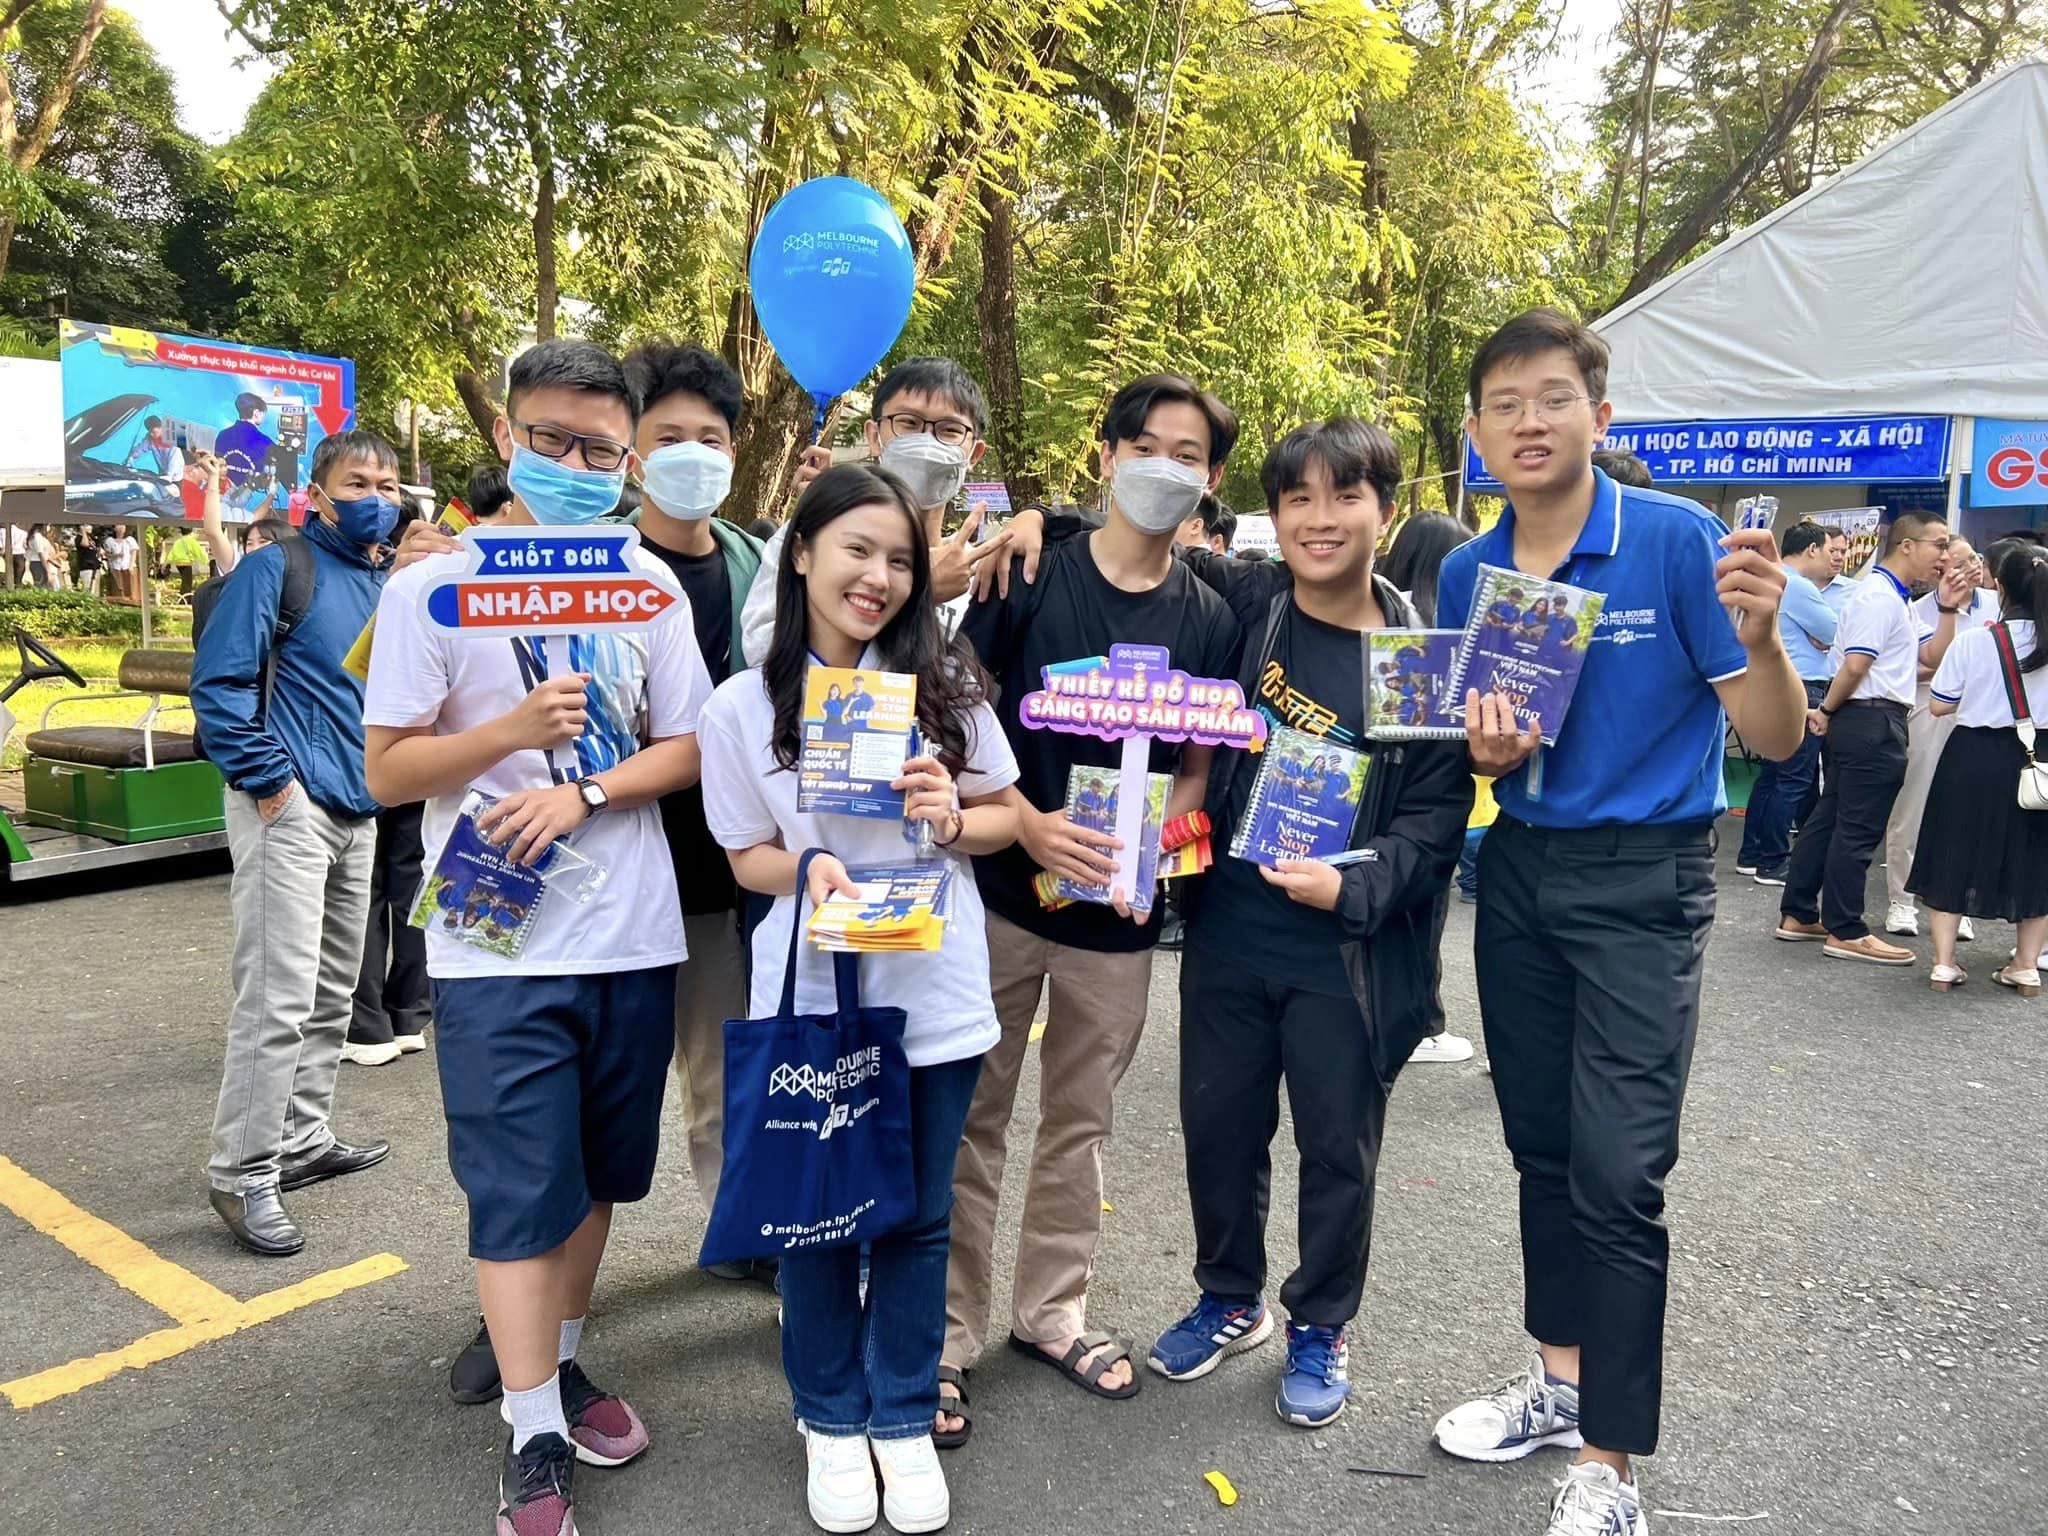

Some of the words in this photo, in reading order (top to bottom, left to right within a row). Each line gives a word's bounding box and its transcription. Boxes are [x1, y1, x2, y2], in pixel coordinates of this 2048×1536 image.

[817, 231, 880, 248] MELBOURNE
[817, 240, 879, 257] POLYTECHNIC
[821, 257, 851, 277] FPT
[167, 349, 198, 364] Xưởng
[199, 354, 220, 366] thực
[222, 357, 238, 369] tập
[259, 362, 287, 375] ngành
[1645, 432, 1690, 454] HỌC
[1696, 430, 1739, 450] LAO
[1745, 427, 1813, 451] ĐỘNG
[1837, 425, 1871, 447] XÃ
[1878, 422, 1924, 450] HỘI
[1669, 459, 1697, 474] TP.
[1704, 452, 1735, 473] HỒ
[1741, 455, 1779, 473] CHÍ
[1786, 457, 1852, 473] MINH
[1986, 447, 2048, 491] G
[494, 541, 554, 568] CHỐT
[564, 547, 609, 567] ĐƠN
[467, 584, 573, 622] NHẬP
[585, 588, 662, 620] HỌC
[1609, 608, 1656, 618] MELBOURNE
[1609, 617, 1656, 626] POLYTECHNIC
[1049, 669, 1114, 698] THIẾT
[1117, 671, 1148, 700] KẾ
[1151, 674, 1185, 703] ĐỒ
[1489, 670, 1538, 694] Never
[853, 710, 910, 721] LEARNING
[1028, 694, 1087, 718] SÁNG
[1089, 702, 1133, 728] TẠO
[1136, 699, 1180, 725] SẢN
[1184, 703, 1254, 733] PHẨM
[1276, 820, 1319, 844] Never
[1278, 833, 1312, 856] Stop
[765, 1120, 800, 1129] Alliance
